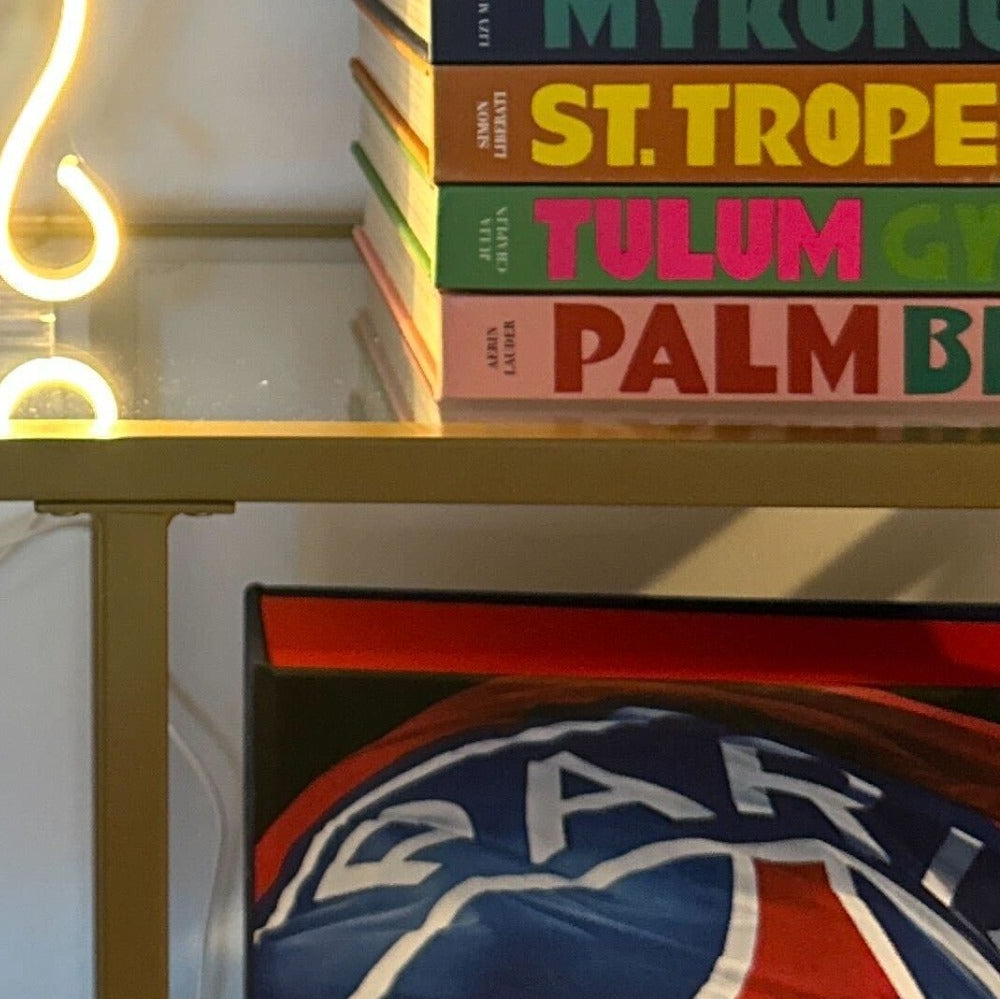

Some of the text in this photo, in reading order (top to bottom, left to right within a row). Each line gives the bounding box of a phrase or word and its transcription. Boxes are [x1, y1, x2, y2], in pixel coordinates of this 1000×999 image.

[476, 100, 491, 150] SIMON
[493, 91, 509, 159] LIBERATI
[533, 198, 1000, 284] TULUM GY
[502, 320, 516, 376] LAUDER
[552, 303, 880, 395] PALM
